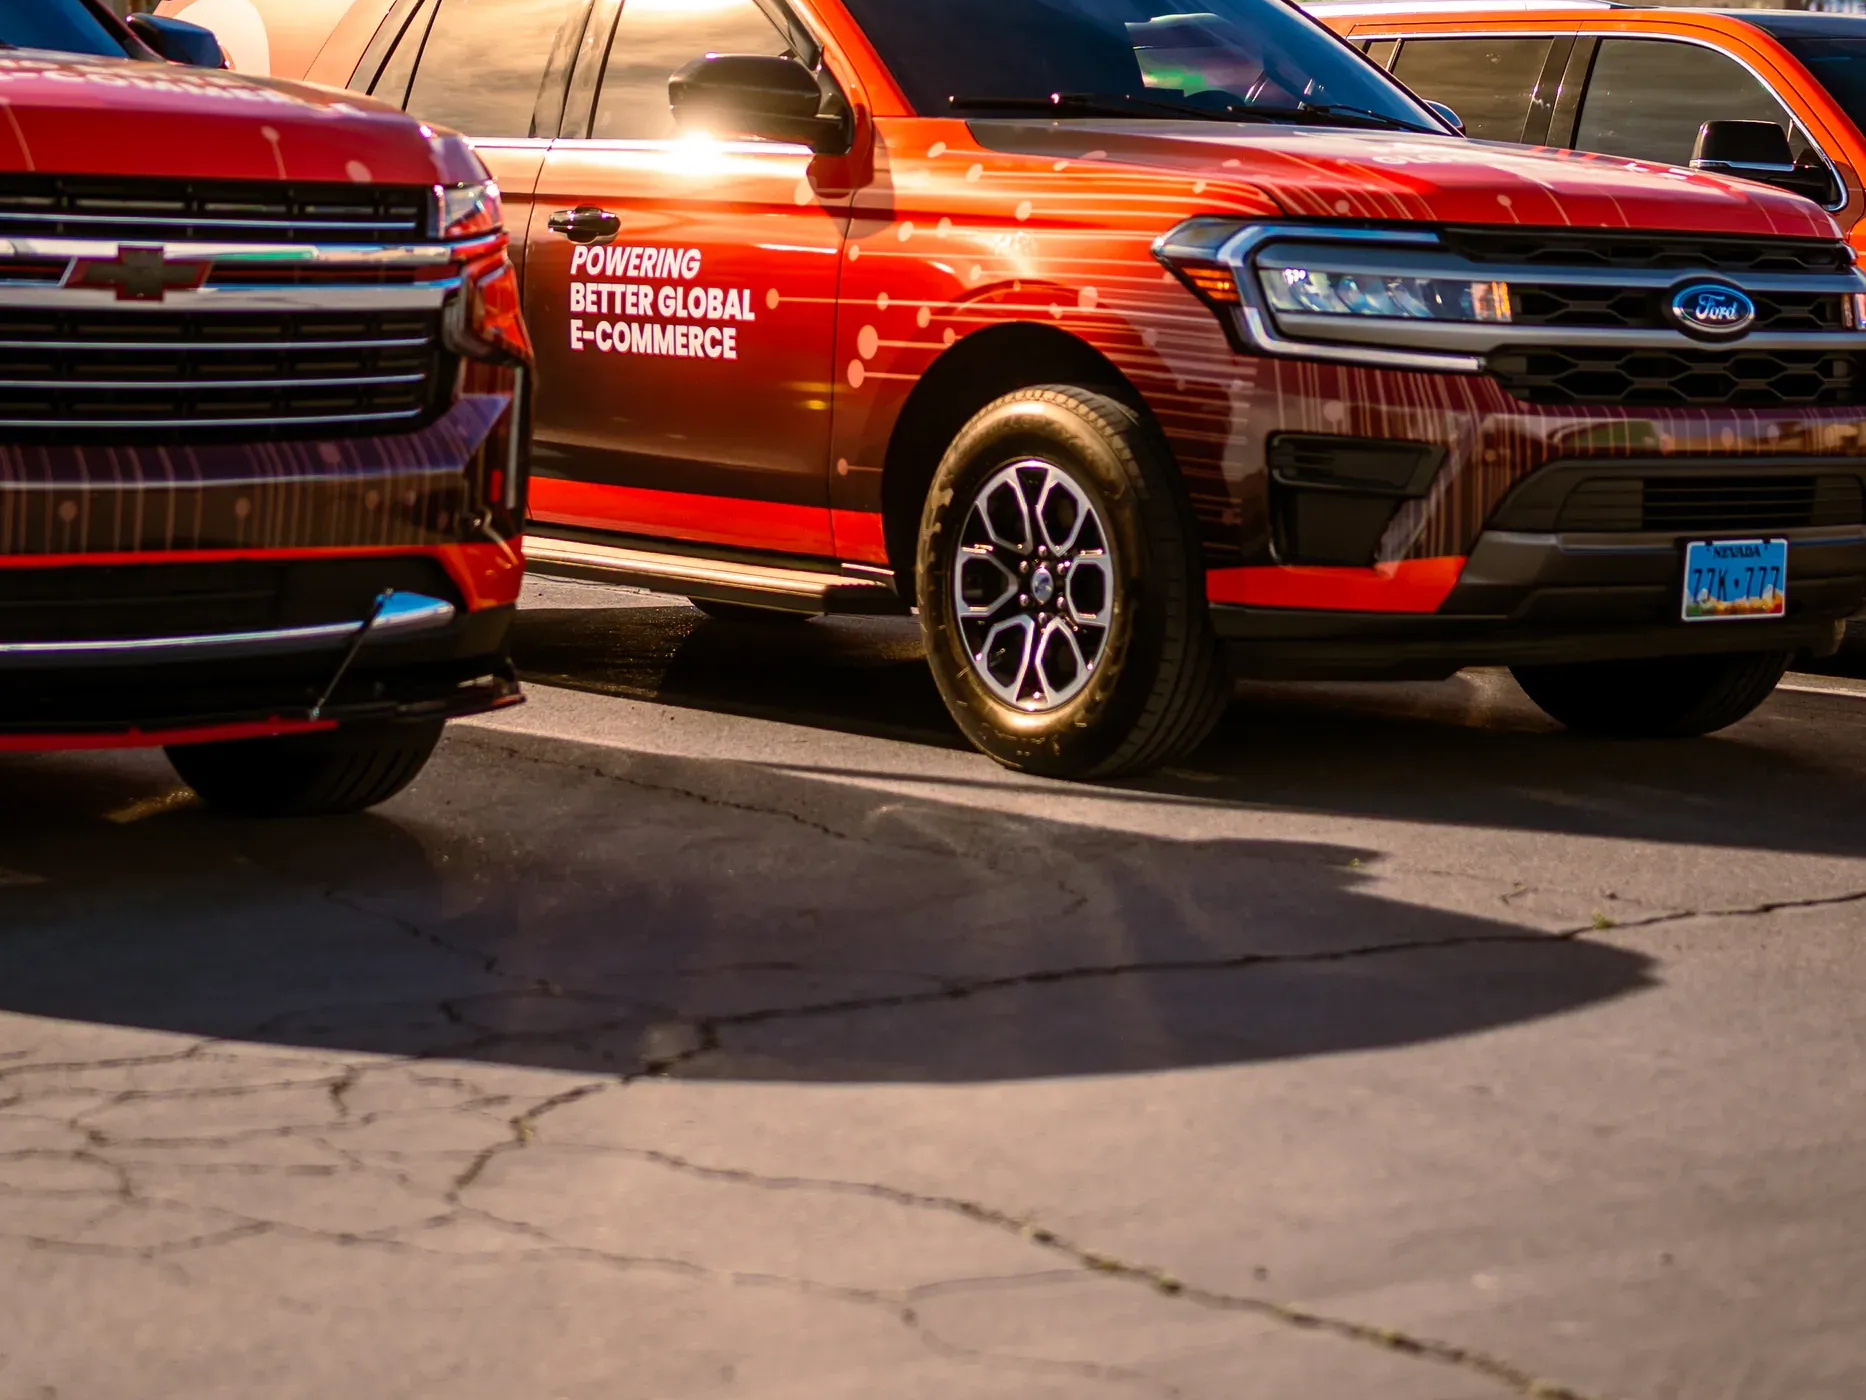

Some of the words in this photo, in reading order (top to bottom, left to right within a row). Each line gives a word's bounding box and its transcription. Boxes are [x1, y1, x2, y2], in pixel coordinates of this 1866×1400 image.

[570, 245, 701, 279] POWERING
[570, 282, 653, 317] BETTER
[657, 286, 755, 321] GLOBAL
[1696, 293, 1738, 320] Ford
[570, 319, 738, 359] E-COMMERCE
[1713, 545, 1762, 559] NEVADA
